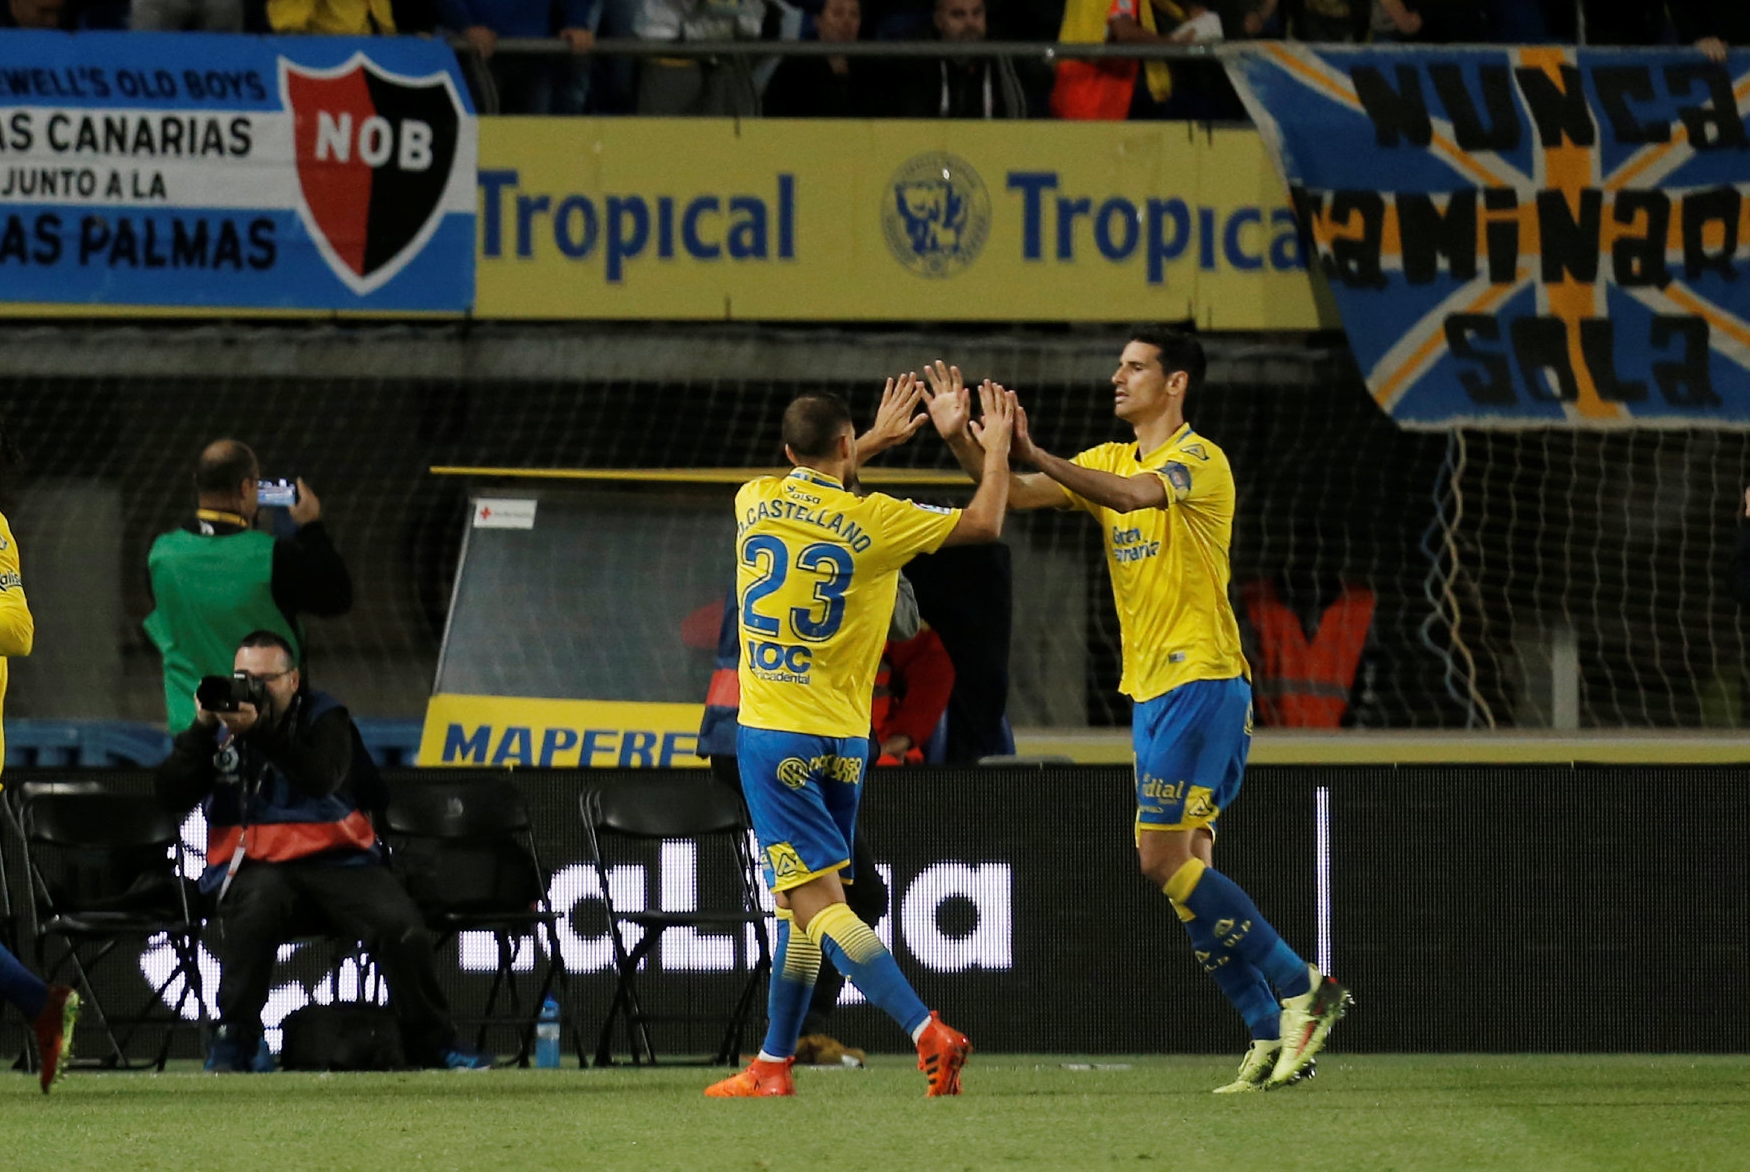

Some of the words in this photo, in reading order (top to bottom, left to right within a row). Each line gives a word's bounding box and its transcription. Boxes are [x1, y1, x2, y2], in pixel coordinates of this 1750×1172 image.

[116, 69, 176, 99] OLD
[182, 70, 267, 101] BOYS
[47, 114, 254, 156] CANARIAS
[314, 110, 435, 173] NOB
[2, 169, 97, 198] JUNTO
[105, 171, 124, 198] A
[132, 171, 167, 200] LA
[77, 215, 277, 270] PALMAS
[477, 169, 794, 282] Tropical
[1006, 171, 1310, 284] Tropica
[742, 534, 855, 643] 23
[442, 724, 698, 768] MAPFRE
